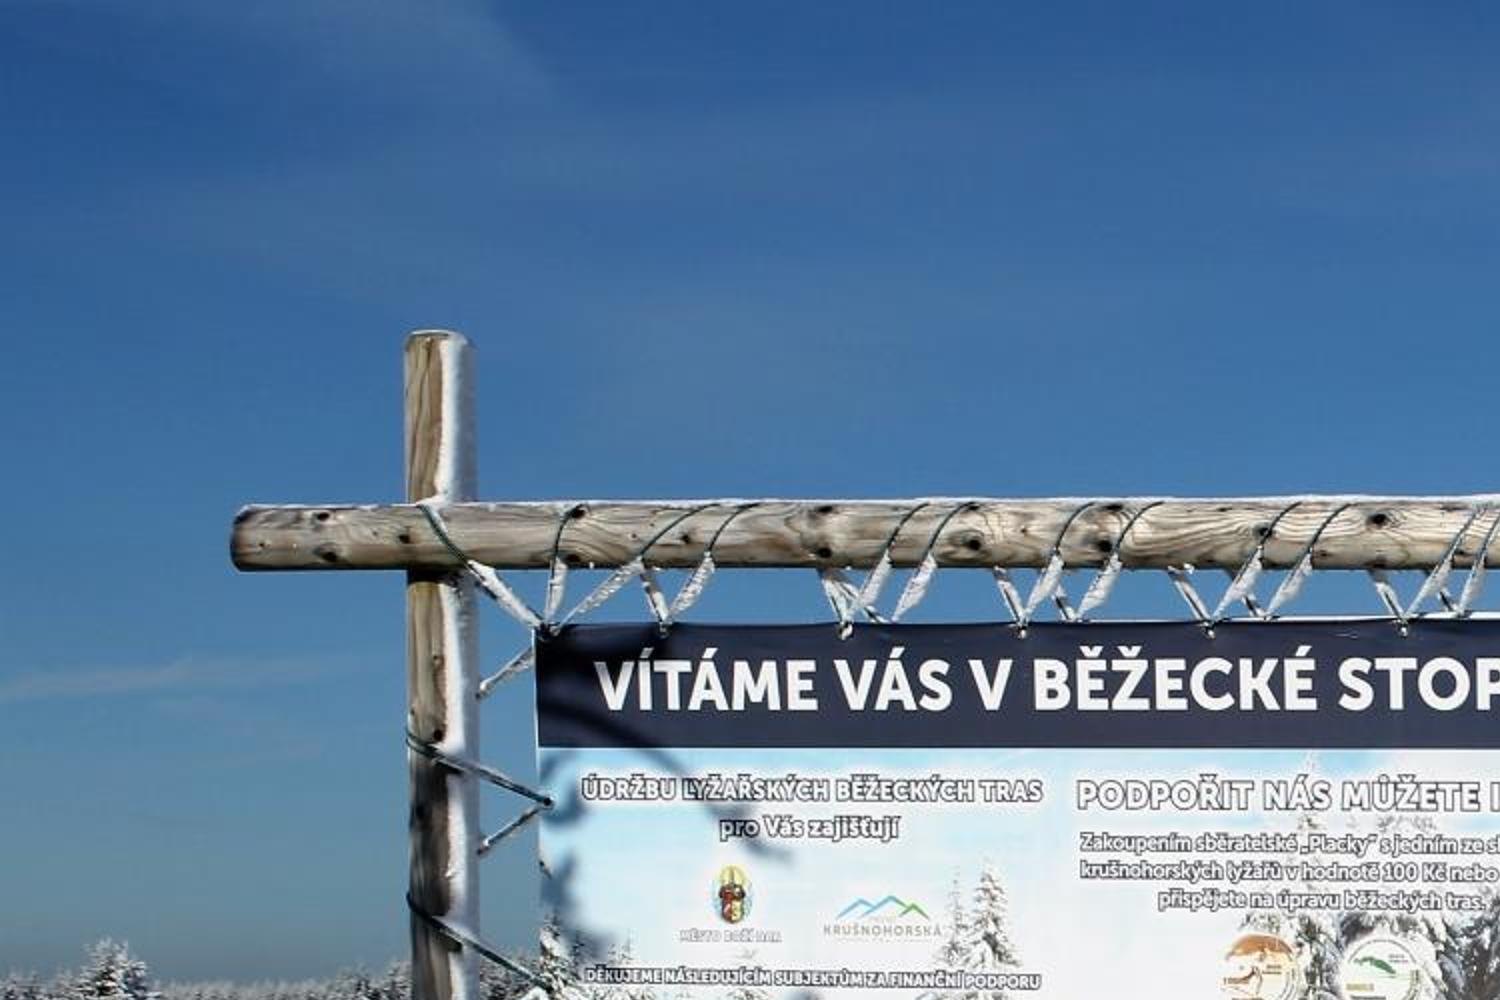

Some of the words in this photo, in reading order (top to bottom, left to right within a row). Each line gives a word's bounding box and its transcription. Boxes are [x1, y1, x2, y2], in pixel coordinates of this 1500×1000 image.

[594, 647, 819, 712] VÍTÁME
[833, 646, 953, 712] VÁS
[967, 659, 1014, 711] V
[1033, 645, 1317, 712] BĚŽECKÉ
[581, 774, 676, 801] ÚDRŽBU
[682, 774, 830, 802] LYŽAŘSKÝCH
[836, 774, 975, 802] BĚŽECKÝCH
[979, 779, 1043, 802] TRAS
[1076, 774, 1254, 811] PODPOŘIT
[1263, 774, 1332, 811] NÁS
[1341, 774, 1480, 812] MŮŽETE
[720, 819, 760, 842] pro
[762, 815, 804, 838] Vás
[808, 815, 901, 843] zajišťují
[1080, 832, 1192, 856] Zakoupením
[1197, 833, 1297, 853] sběratelské
[1380, 839, 1391, 854] s
[1391, 834, 1457, 857] jedním
[1461, 838, 1484, 854] ze
[1080, 860, 1223, 884] krušnohorských
[1226, 861, 1283, 884] lyžařů
[1286, 866, 1299, 880] v
[1301, 862, 1380, 882] hodnotě
[1382, 863, 1418, 881] 100
[1422, 862, 1448, 882] Kč
[1450, 863, 1499, 882] nebo
[1158, 888, 1248, 912] přispějete
[1250, 893, 1273, 908] na
[1276, 890, 1340, 912] úpravu
[1344, 889, 1442, 914] běžeckých
[1446, 892, 1486, 911] tras.
[585, 963, 663, 985] DĚKUJEME
[664, 965, 772, 986] NÁSLEDUJÍCÍM
[774, 968, 865, 988] SUBJEKTŮM
[866, 971, 886, 988] ZA
[887, 969, 964, 989] FINANČNÍ
[965, 973, 1042, 991] PODPORU
